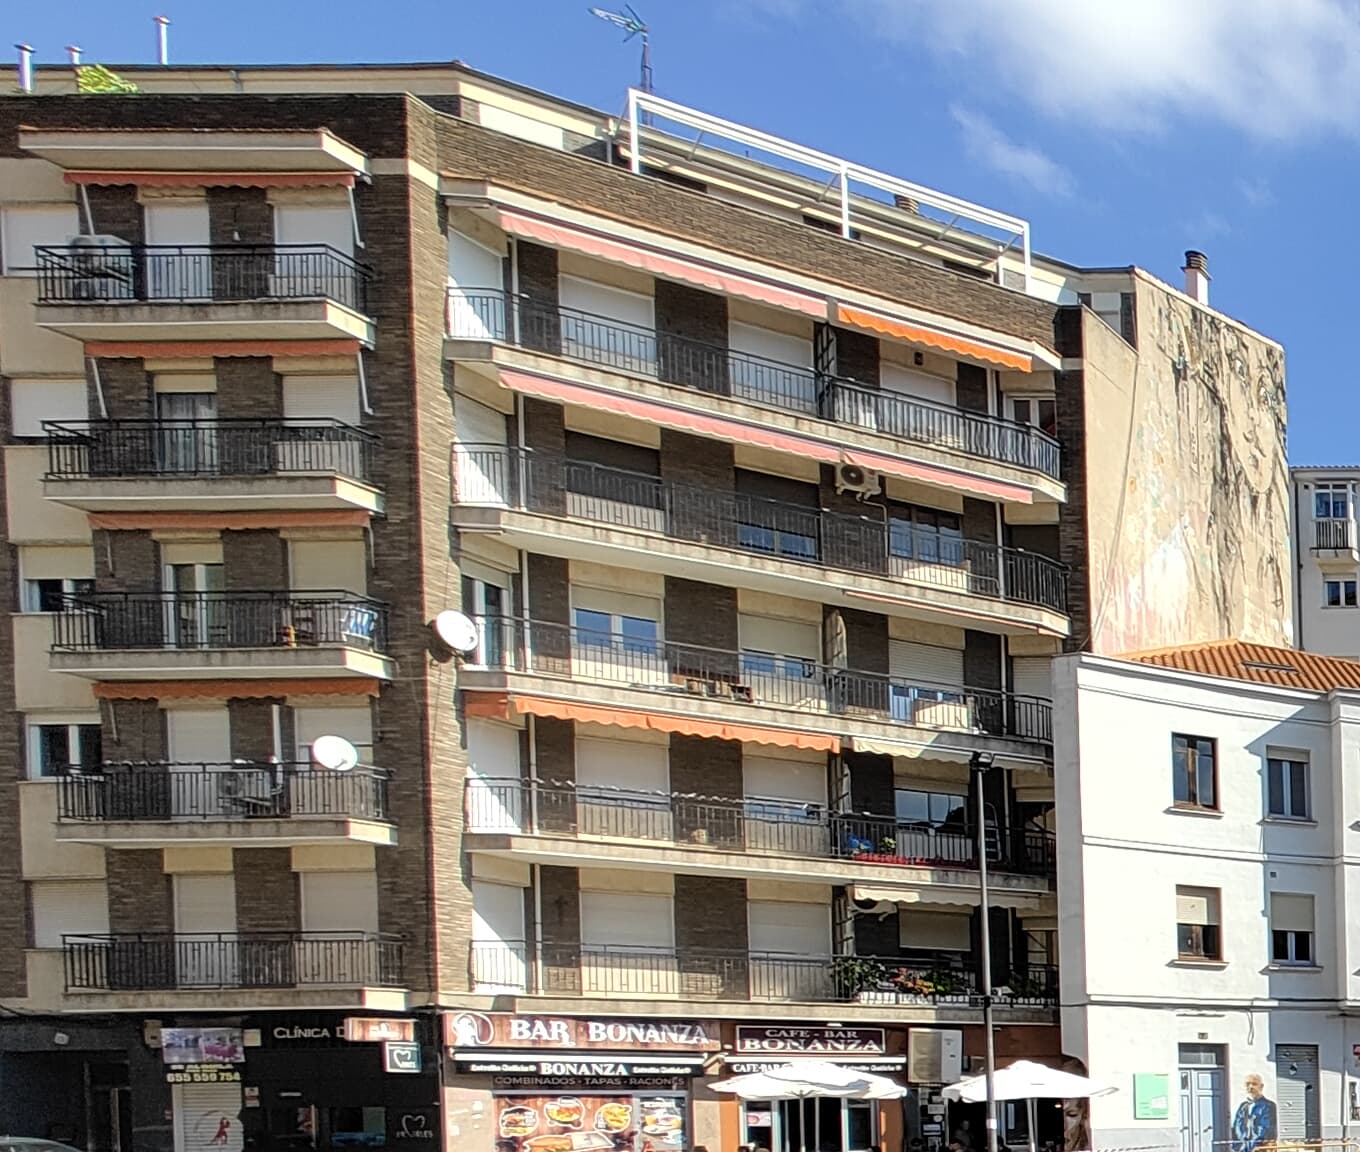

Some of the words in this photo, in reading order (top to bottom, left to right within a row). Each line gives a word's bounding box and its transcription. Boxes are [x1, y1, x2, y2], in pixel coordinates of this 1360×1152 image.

[273, 1025, 330, 1039] CLÍNICA
[511, 1019, 575, 1047] BAR
[588, 1022, 709, 1045] BONANZA
[824, 1031, 858, 1039] BAR
[743, 1038, 881, 1051] BONANZA
[540, 1062, 628, 1076] BONANZA
[495, 1076, 577, 1085] COMBINADOS
[585, 1077, 623, 1086] TAPAS
[629, 1077, 685, 1086] RACIONES
